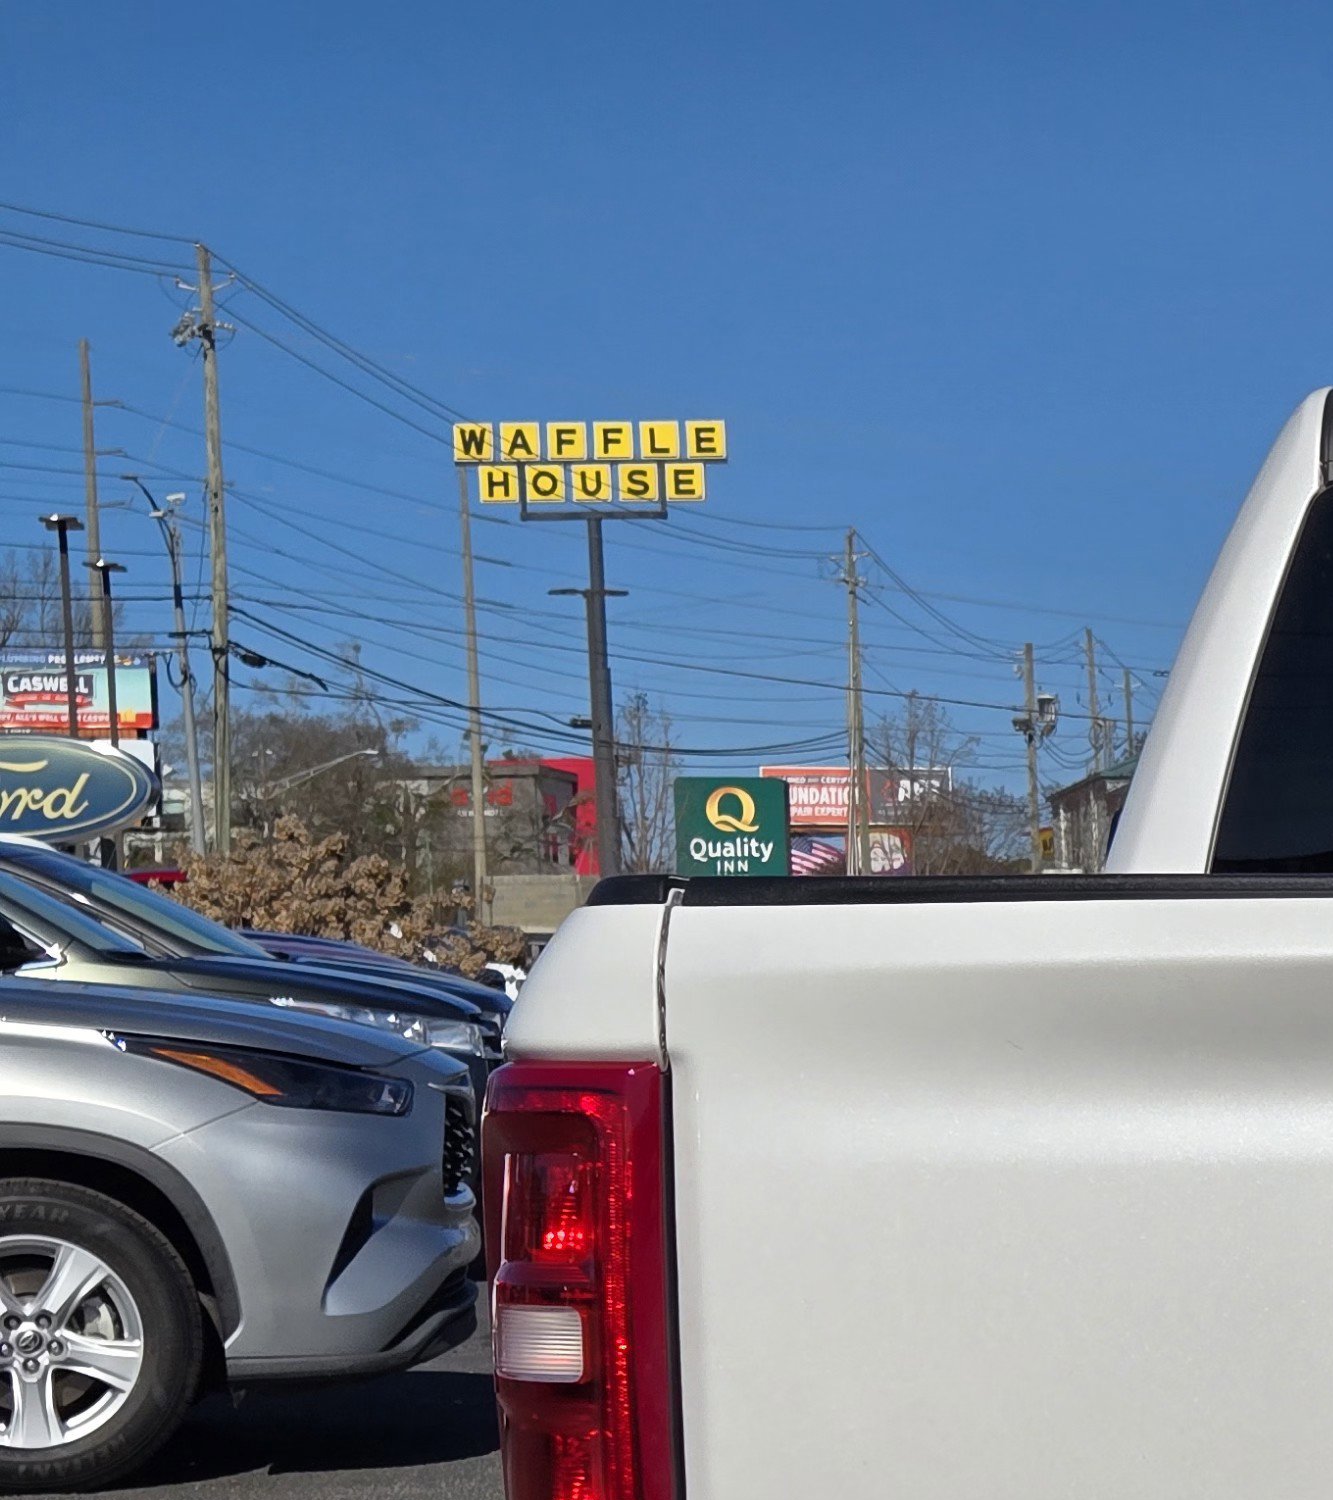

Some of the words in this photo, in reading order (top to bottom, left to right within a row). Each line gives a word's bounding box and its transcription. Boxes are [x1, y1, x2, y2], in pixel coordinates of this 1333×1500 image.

[459, 427, 717, 456] WAFFLE
[487, 468, 696, 498] HOUSE
[7, 675, 89, 693] CASWEL
[706, 786, 759, 832] Q
[690, 837, 774, 863] Quality
[717, 860, 749, 873] INN
